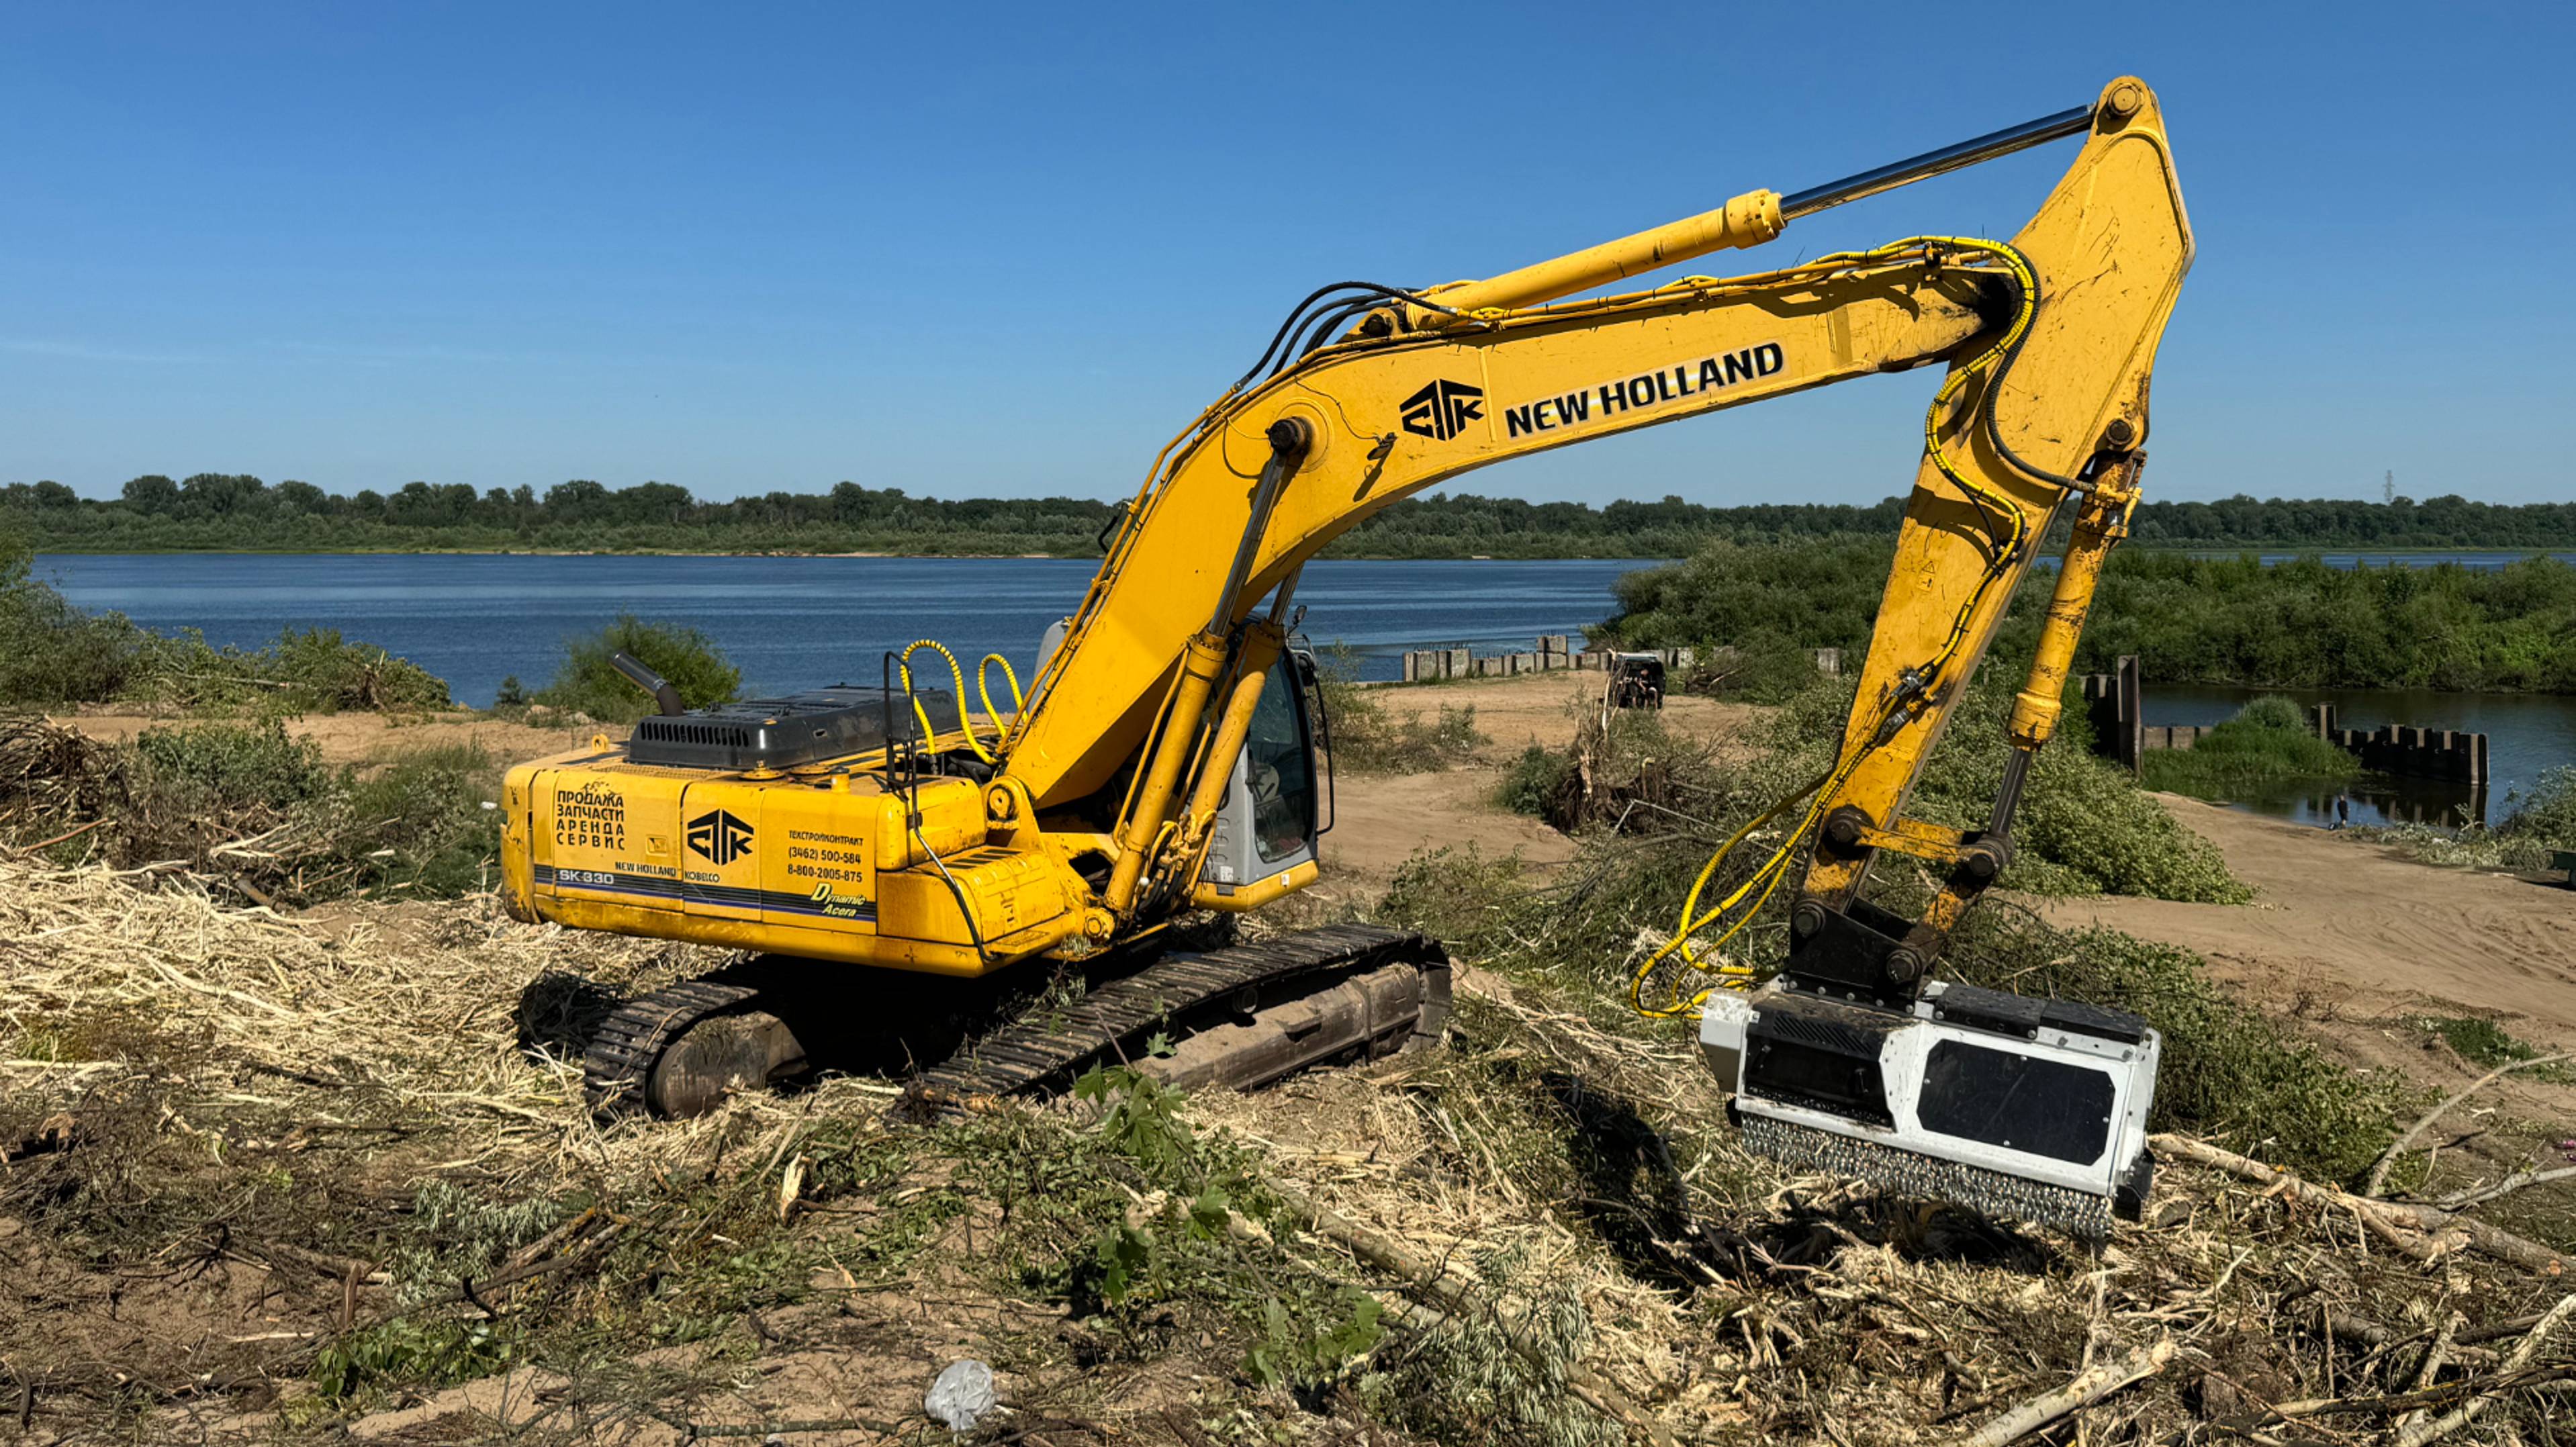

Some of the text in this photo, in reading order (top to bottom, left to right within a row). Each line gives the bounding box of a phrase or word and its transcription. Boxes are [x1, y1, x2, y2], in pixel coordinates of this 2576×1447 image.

[1505, 341, 1784, 438] NEW HOLLAND
[558, 790, 624, 808] ПРОДАЖА
[557, 804, 625, 822] ЗАПЧАСТИ
[556, 819, 625, 836] АРЕНДА
[556, 832, 625, 851] СЕРВИС
[789, 830, 864, 846] ТЕХСТРОЙКОНТРАКТ
[788, 846, 862, 864] (3462) 500-584
[615, 861, 677, 876] NEW HOLLAND
[685, 870, 721, 882] KOBELCO
[788, 863, 863, 883] 8-800-2005-875
[811, 882, 867, 906] Dynamic
[822, 903, 858, 917] Acera
